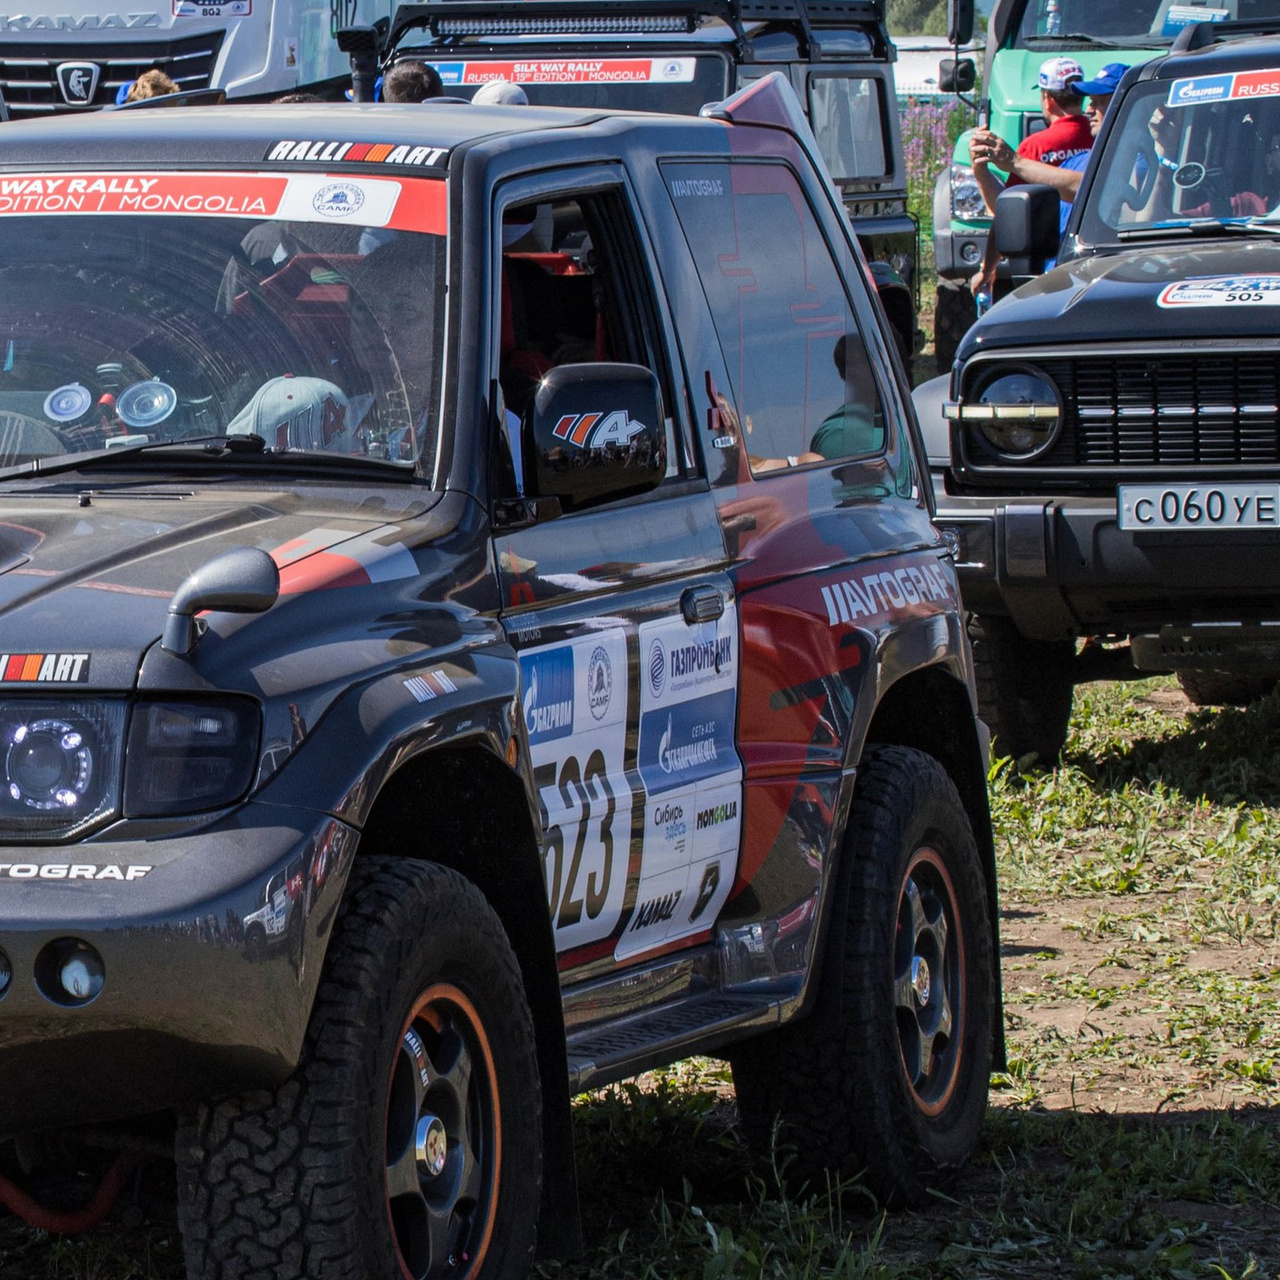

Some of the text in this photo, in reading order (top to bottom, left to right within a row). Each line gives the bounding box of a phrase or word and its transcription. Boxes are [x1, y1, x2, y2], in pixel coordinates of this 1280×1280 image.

[0, 12, 161, 31] KAMAZ
[202, 8, 221, 16] 802
[467, 73, 505, 82] RUSSIA
[533, 72, 576, 81] EDITION
[589, 71, 646, 81] MONGOLIA
[513, 62, 603, 72] SILK WAY RALLY
[1, 179, 63, 196] WAY
[67, 178, 160, 194] RALLY
[118, 194, 267, 213] MONGOLIA
[1225, 293, 1264, 302] 505
[671, 636, 731, 677] ГАЗПРОМБАНК
[37, 654, 89, 681] ART
[536, 700, 572, 732] GAZPROM
[691, 724, 705, 738] СЕТЬ
[654, 804, 684, 826] Сибирь
[696, 800, 737, 831] MONGOLIA
[533, 748, 615, 931] 523
[665, 822, 687, 841] здесь
[629, 890, 683, 933] KAMAZ
